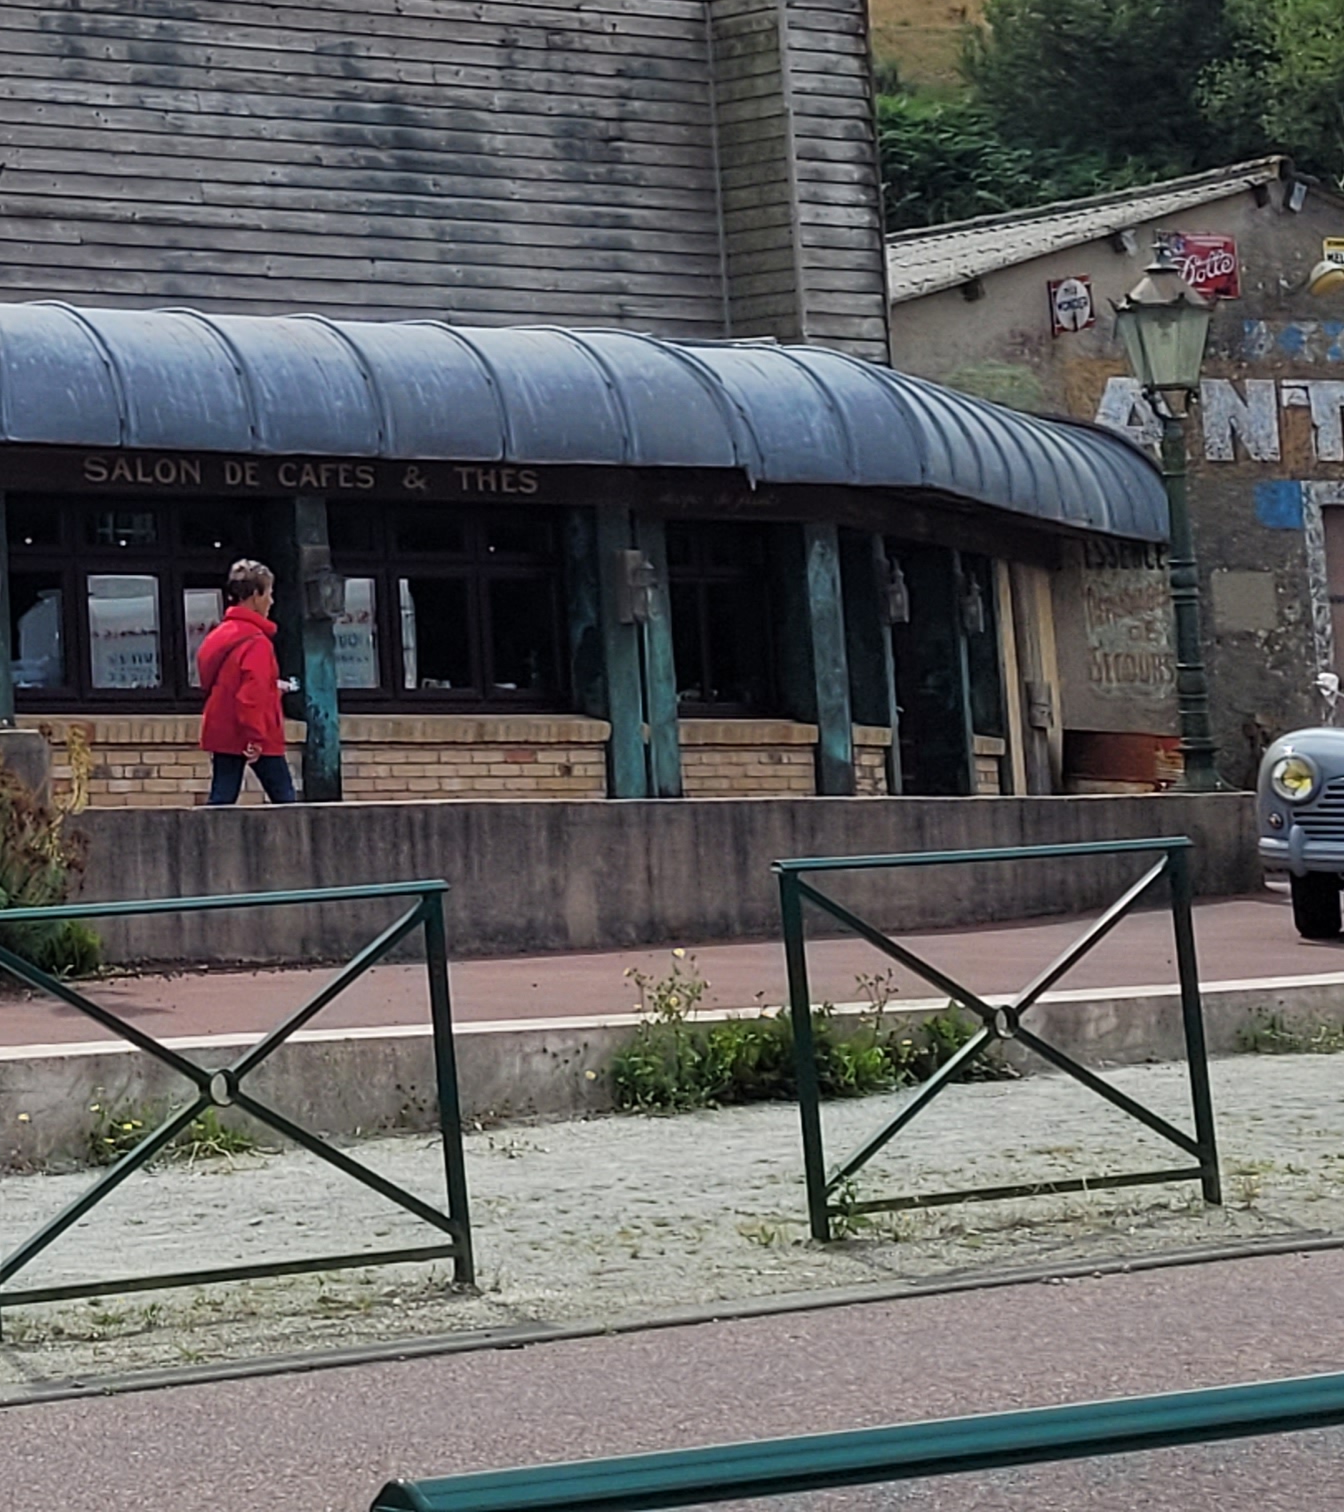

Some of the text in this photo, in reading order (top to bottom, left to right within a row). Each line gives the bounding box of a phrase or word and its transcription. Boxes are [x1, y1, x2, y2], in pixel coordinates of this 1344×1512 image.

[83, 456, 540, 494] SALON DE CAFES & THES
